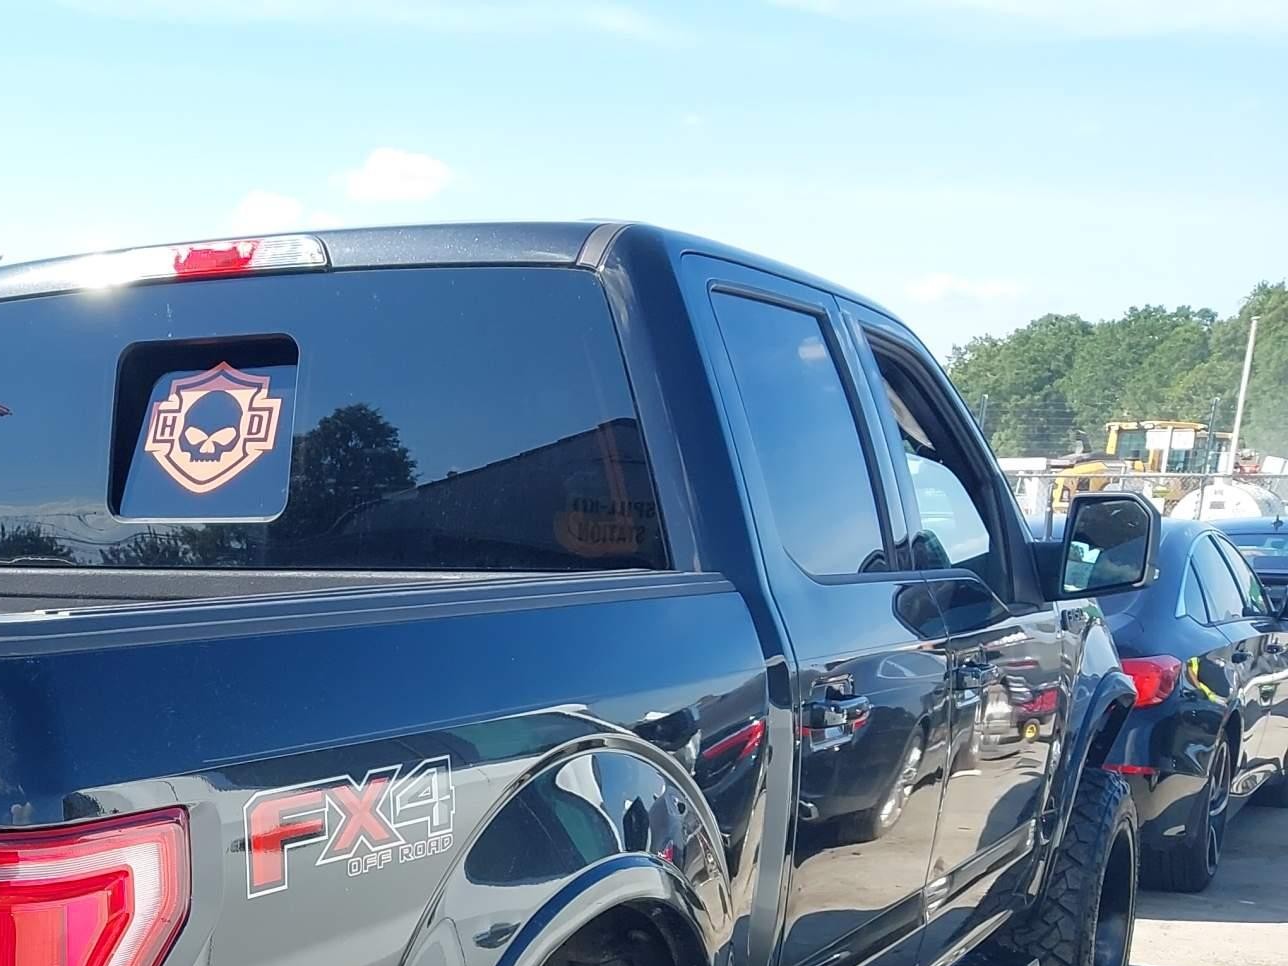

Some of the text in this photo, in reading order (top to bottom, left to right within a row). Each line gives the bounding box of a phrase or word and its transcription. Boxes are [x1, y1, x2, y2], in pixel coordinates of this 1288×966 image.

[160, 413, 264, 437] H D
[243, 754, 456, 900] FX4
[347, 833, 454, 877] OFF ROAD
